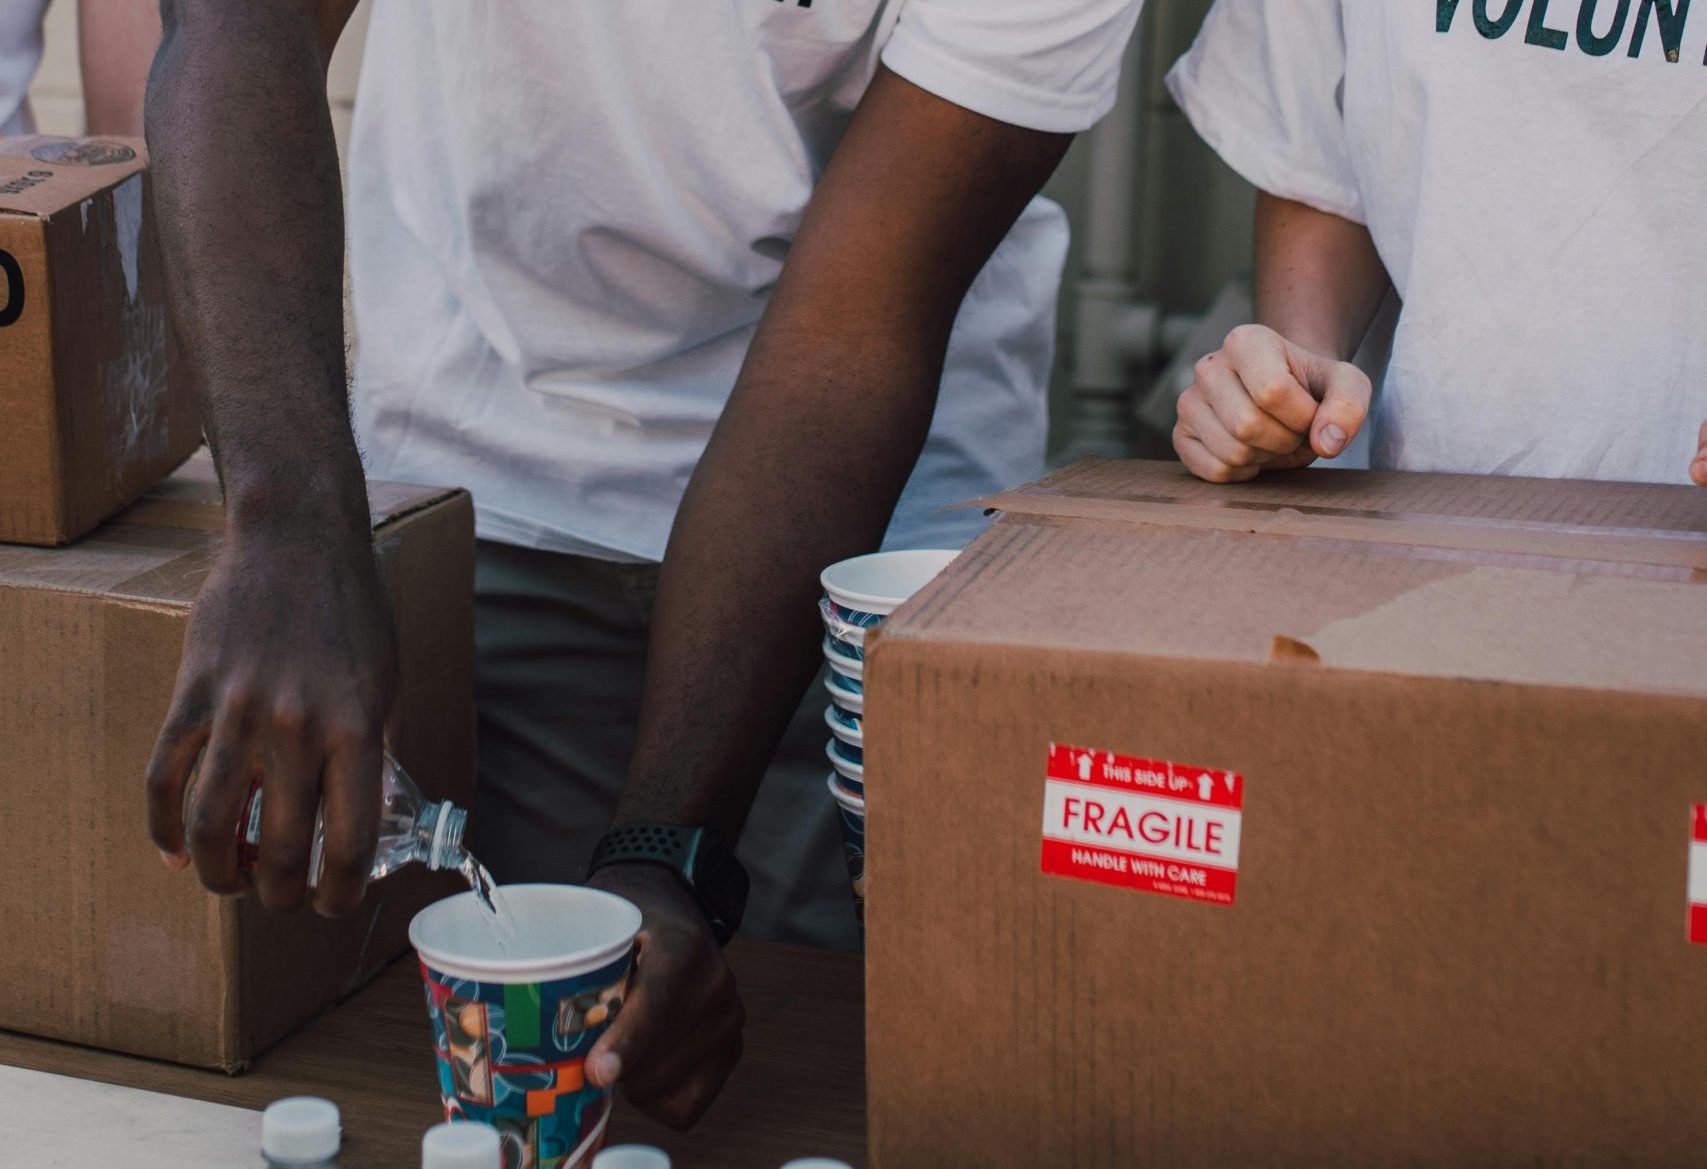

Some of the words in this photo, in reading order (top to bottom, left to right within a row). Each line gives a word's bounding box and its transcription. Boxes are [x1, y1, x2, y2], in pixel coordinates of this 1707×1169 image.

[1104, 764, 1131, 783] THIS
[1134, 769, 1165, 788] SIDE
[1169, 774, 1188, 791] UP
[1063, 797, 1223, 854] FRAGILE
[1072, 850, 1127, 872] HANDLE
[1132, 859, 1165, 878] WITH
[1167, 866, 1208, 886] CARE
